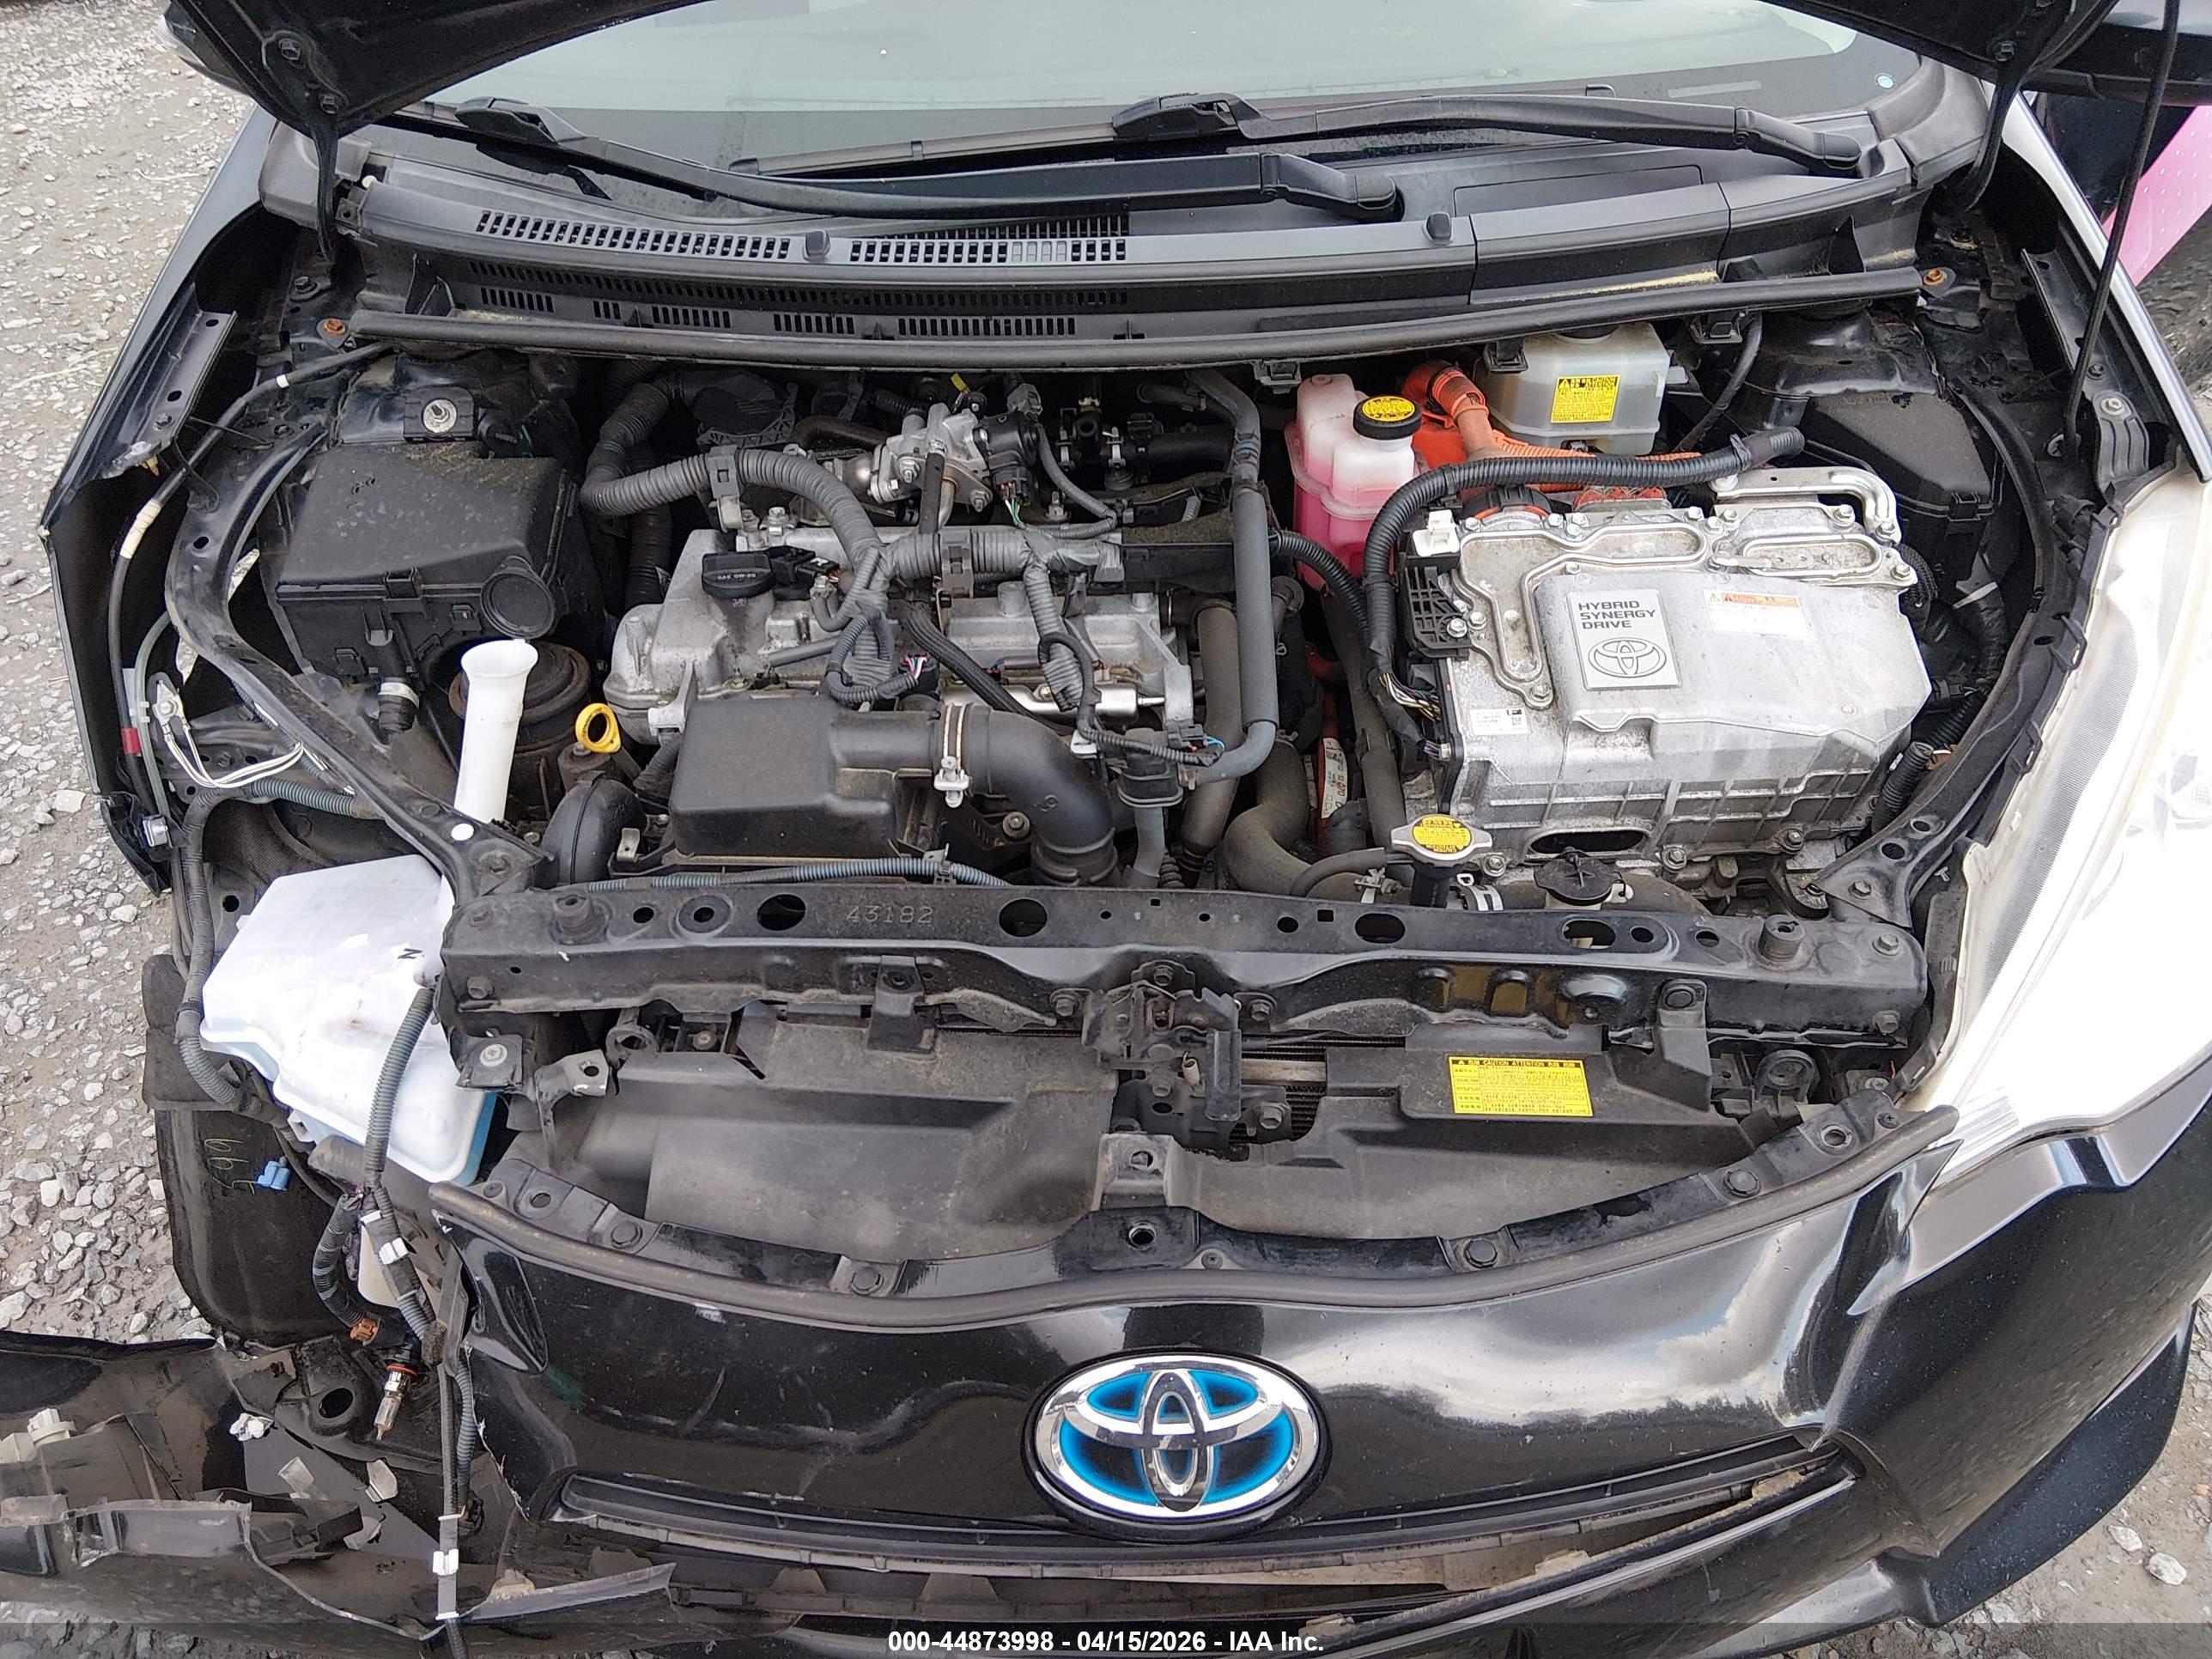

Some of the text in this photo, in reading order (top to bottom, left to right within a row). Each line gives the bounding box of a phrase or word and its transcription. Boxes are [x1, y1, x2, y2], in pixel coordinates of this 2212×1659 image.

[1578, 600, 1640, 611] HYBRID
[1579, 609, 1656, 620] SYNERGY
[1582, 620, 1632, 629] DRIVE
[846, 904, 933, 924] 43182
